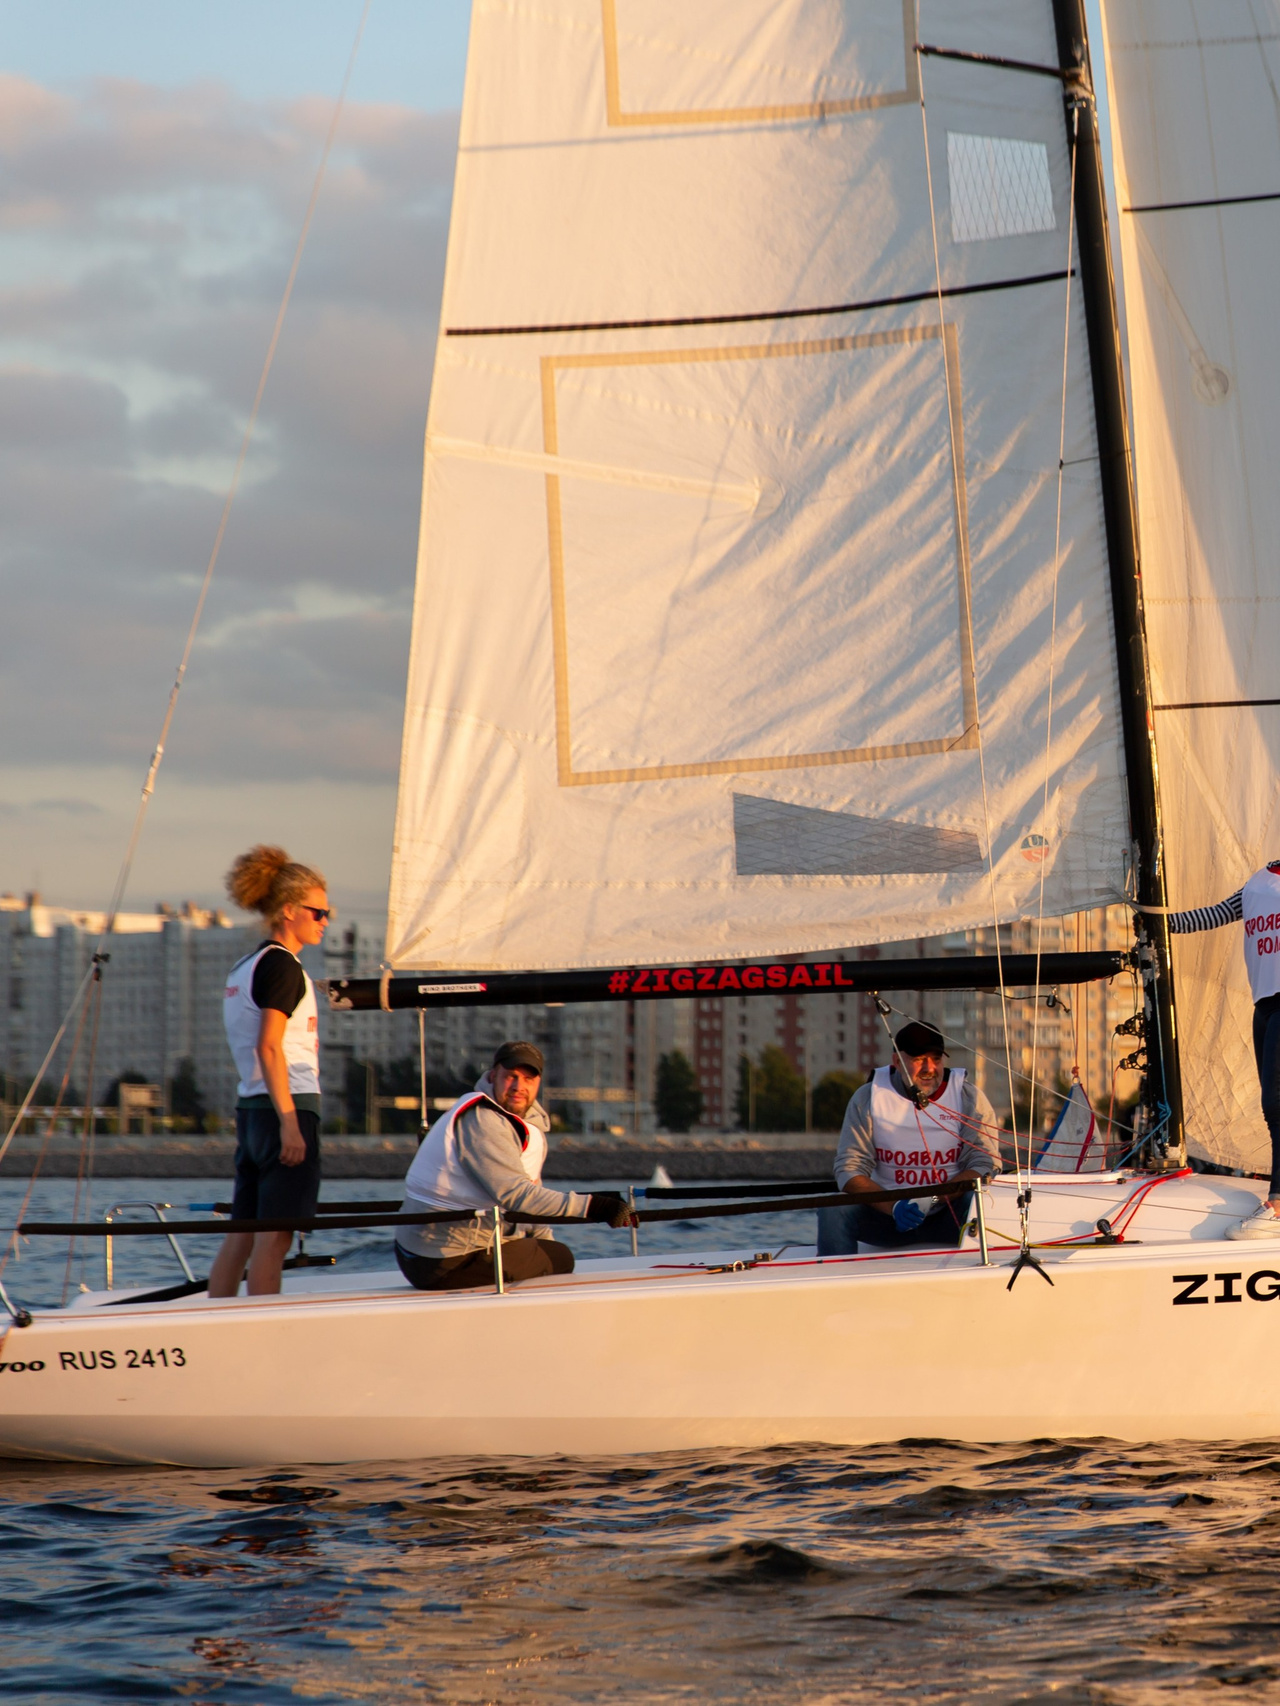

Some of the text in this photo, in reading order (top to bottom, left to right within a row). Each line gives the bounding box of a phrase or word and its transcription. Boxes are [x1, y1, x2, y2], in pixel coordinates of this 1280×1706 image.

[442, 984, 478, 992] BROTHERS
[607, 964, 854, 993] #ZIGZAGSAIL
[894, 1168, 948, 1185] ВОЛЮ
[59, 1350, 117, 1370] RUS
[125, 1347, 186, 1368] 2413
